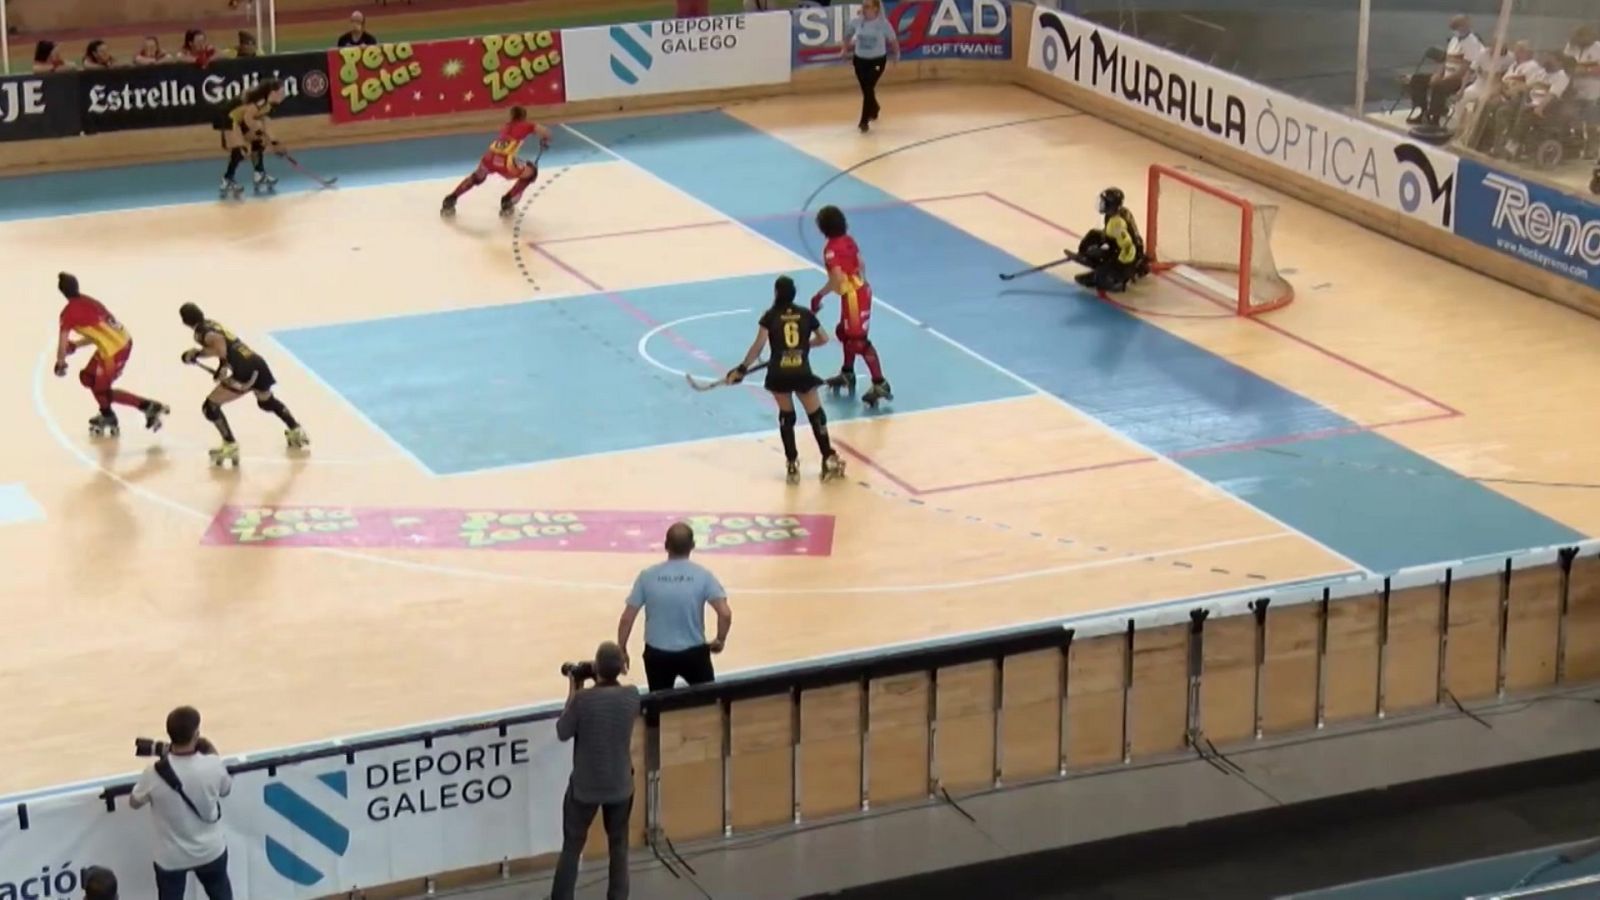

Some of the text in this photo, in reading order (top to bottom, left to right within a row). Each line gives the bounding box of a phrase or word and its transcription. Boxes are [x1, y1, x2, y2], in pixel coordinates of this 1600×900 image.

[661, 15, 746, 36] DEPORTE
[661, 34, 737, 54] GALEGO
[339, 42, 413, 83] Peta
[482, 30, 554, 72] Peta
[922, 43, 1003, 56] SOFTWARE
[88, 70, 298, 113] Estrella Galia
[341, 61, 422, 113] Zetas
[483, 50, 561, 101] Zetas
[0, 80, 46, 122] JE
[1090, 29, 1246, 145] MURALLA
[1256, 99, 1380, 198] ÒPTICA
[784, 321, 799, 348] 6
[366, 739, 529, 789] DEPORTE
[367, 775, 511, 821] GALEGO
[0, 861, 86, 900] ació
